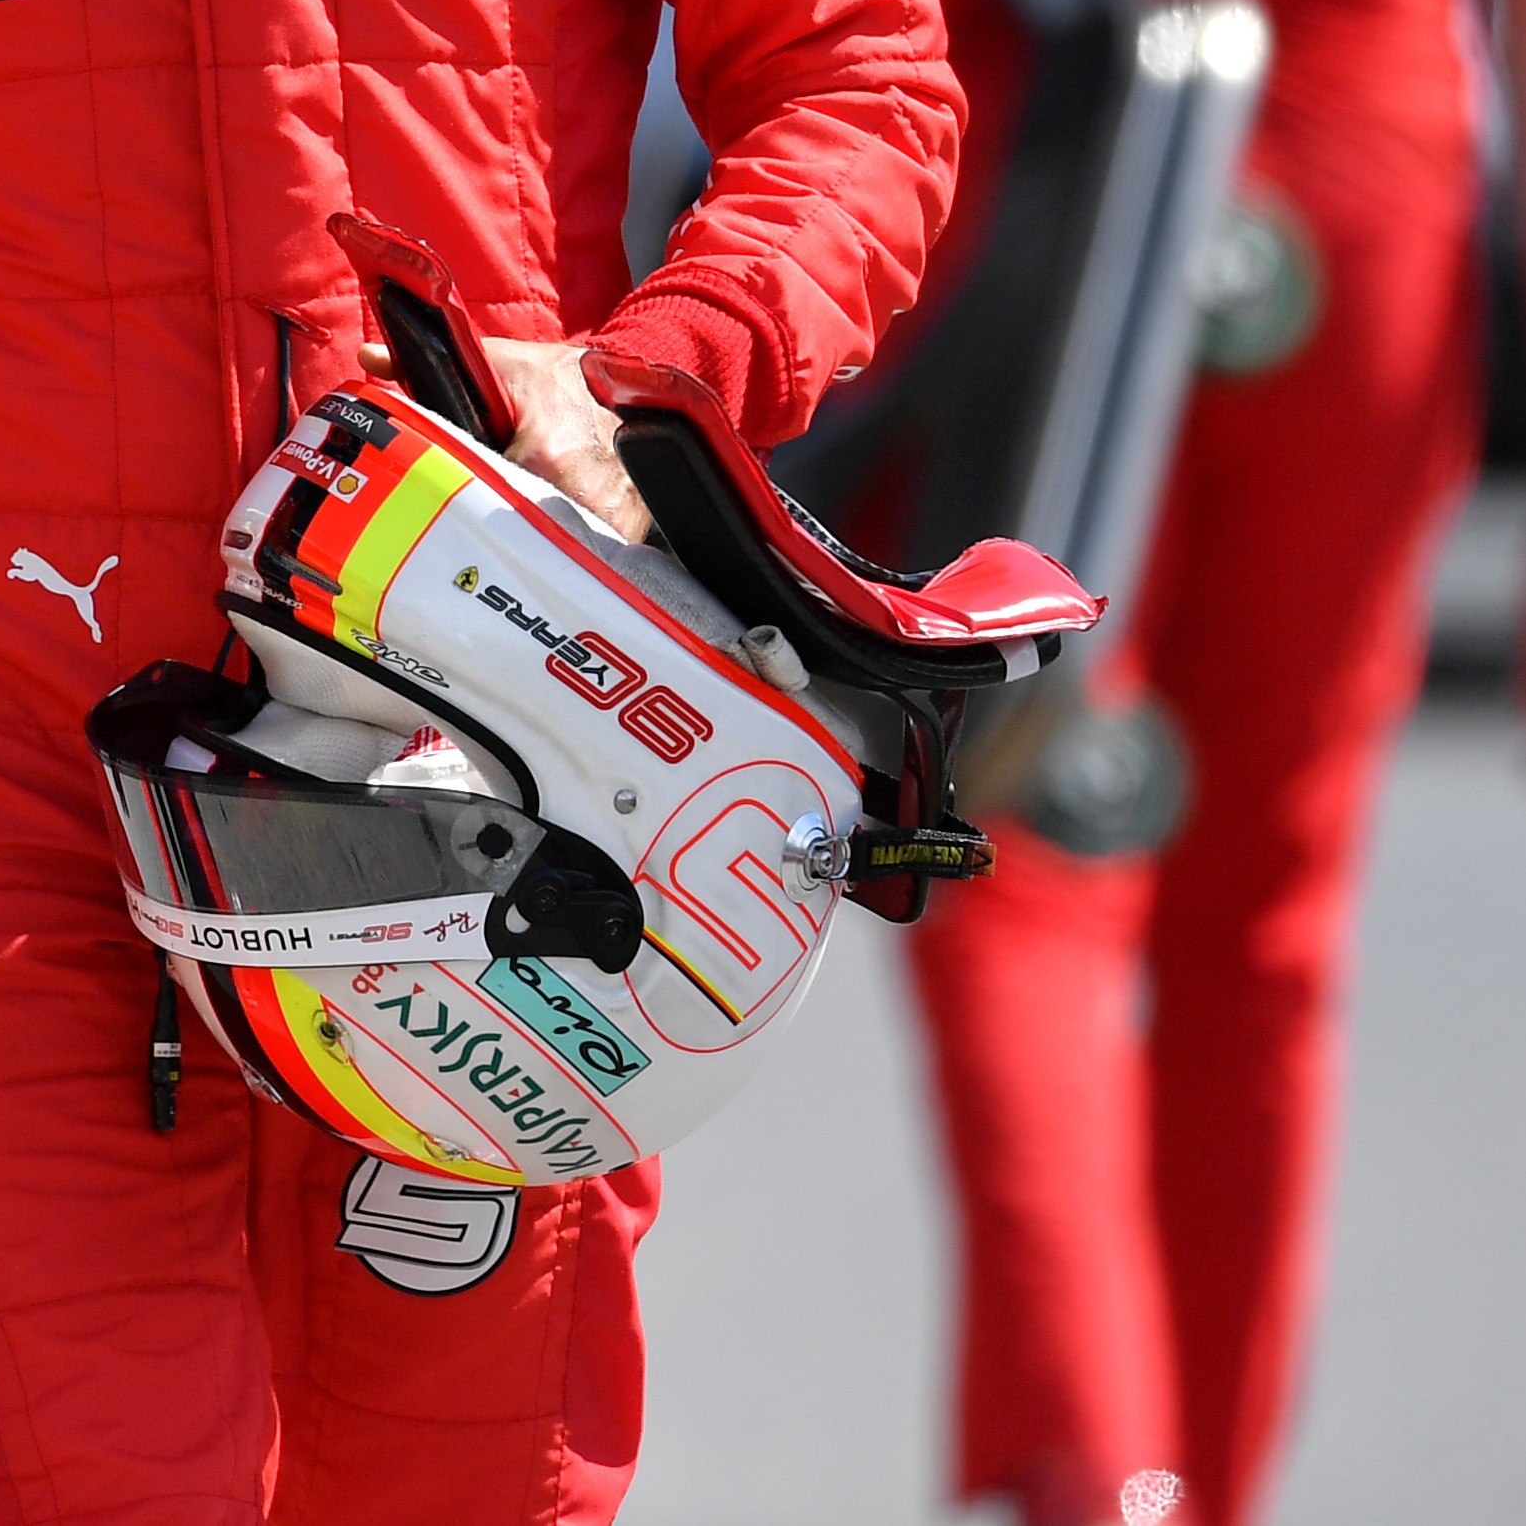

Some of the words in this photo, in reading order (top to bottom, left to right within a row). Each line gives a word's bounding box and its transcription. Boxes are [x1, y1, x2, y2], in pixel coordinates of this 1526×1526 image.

[282, 441, 339, 480] V-Power
[475, 584, 610, 687] YEARS
[545, 630, 714, 765] 90
[189, 923, 313, 952] HUBLOT
[373, 980, 604, 1175] KASPERSKY
[334, 1158, 522, 1268] 5
